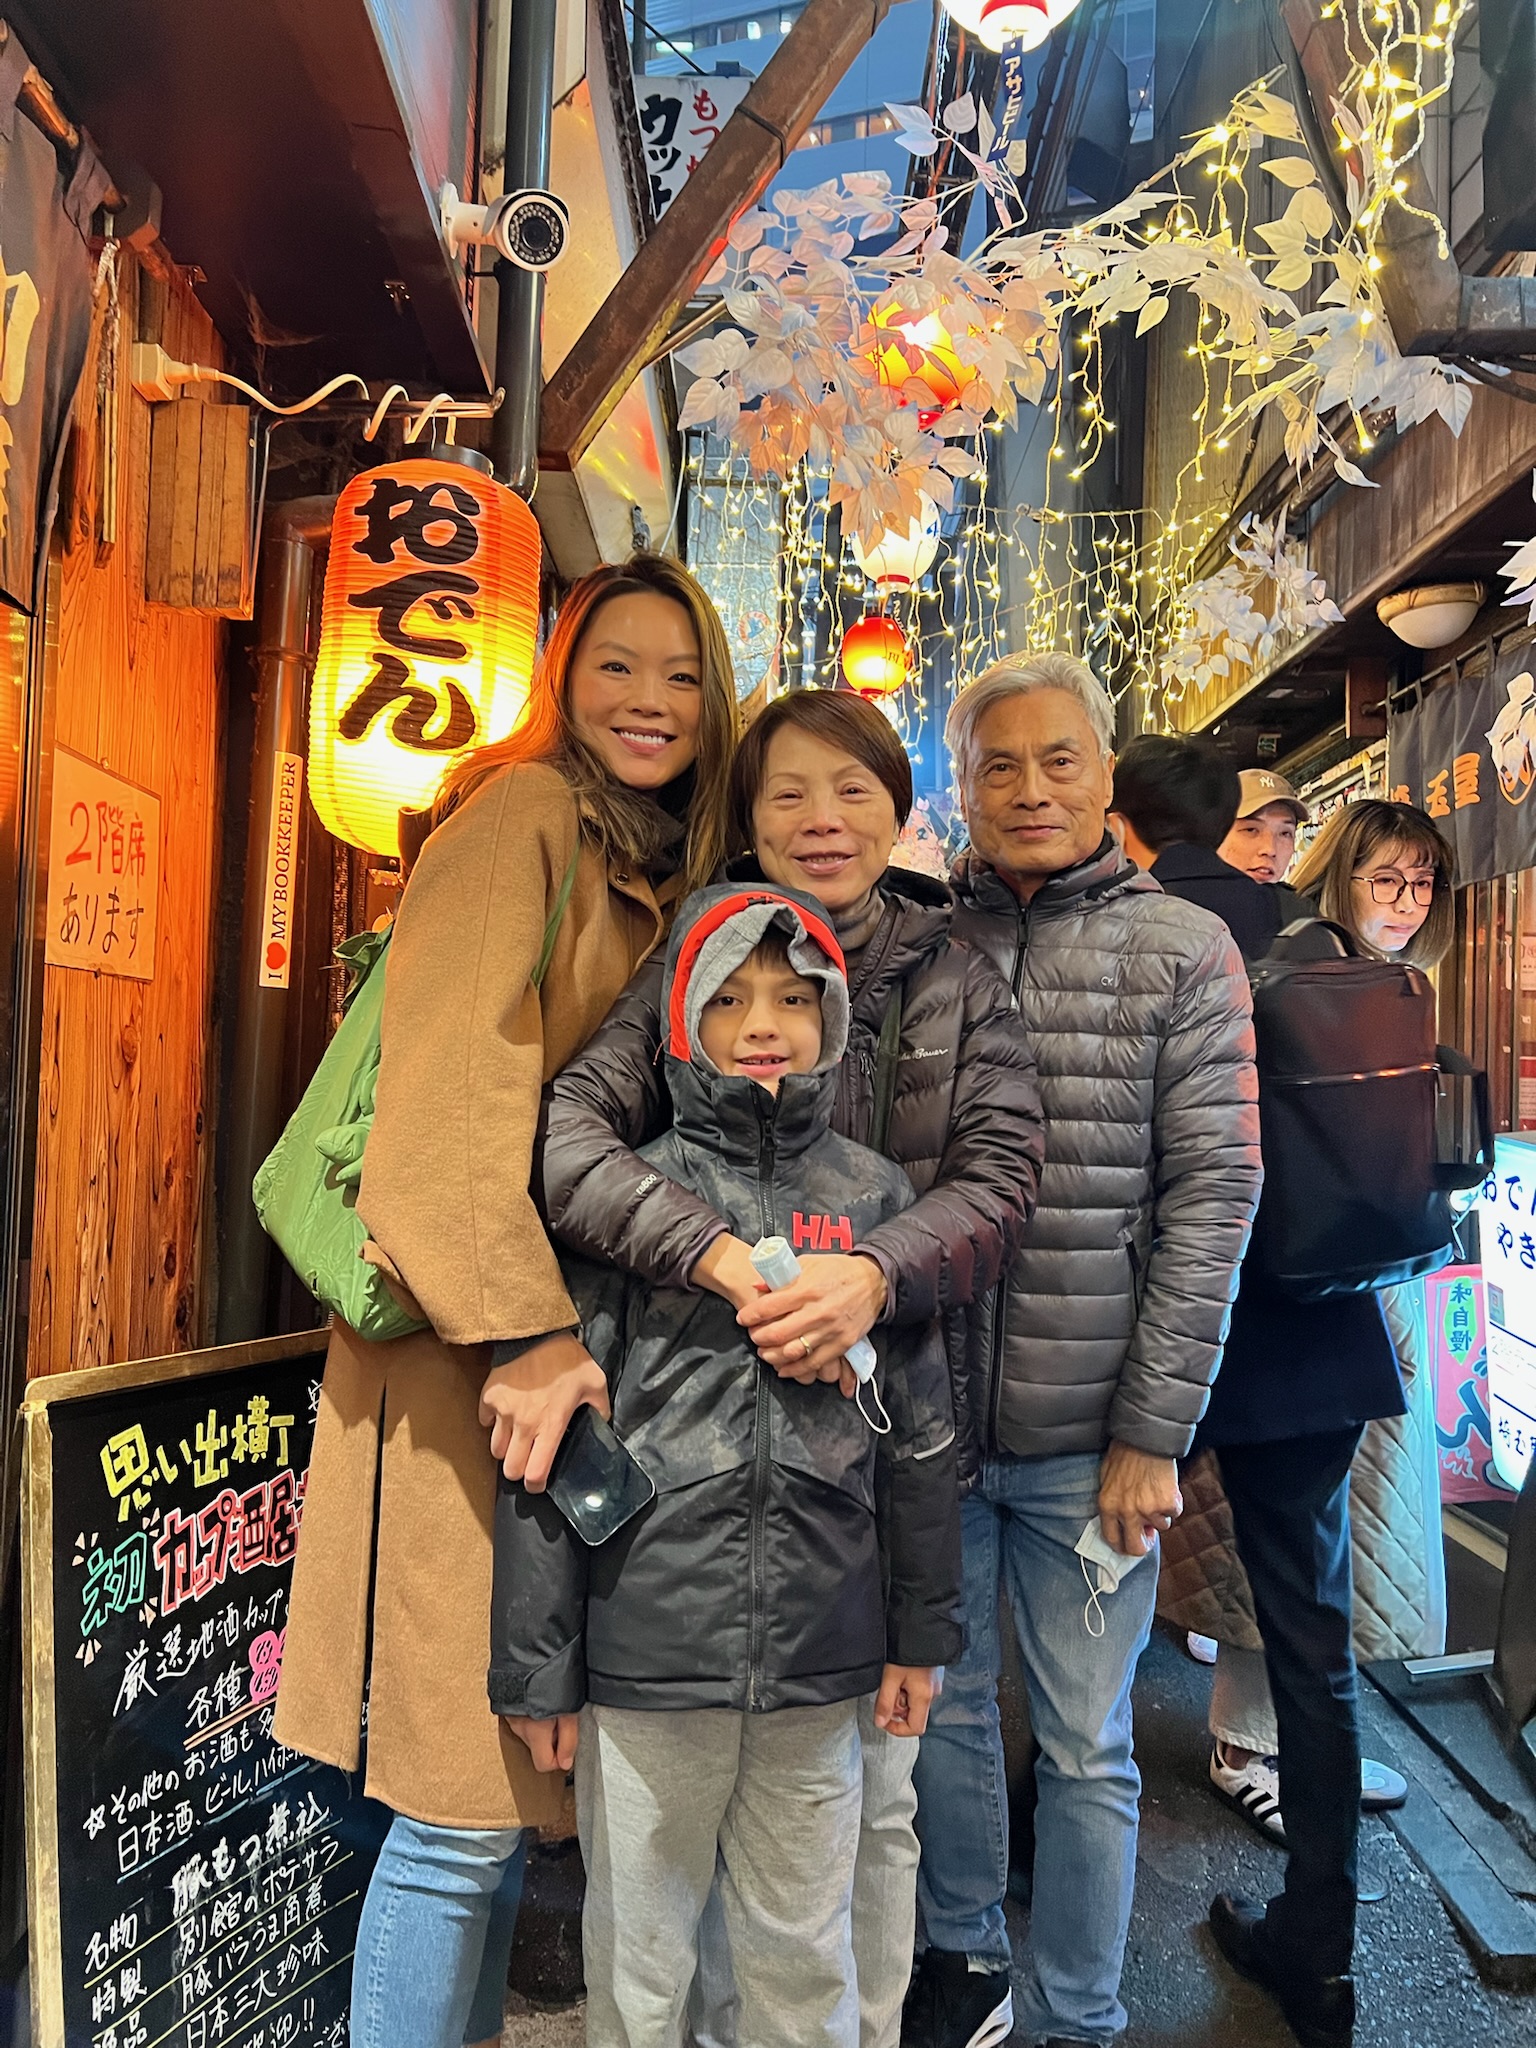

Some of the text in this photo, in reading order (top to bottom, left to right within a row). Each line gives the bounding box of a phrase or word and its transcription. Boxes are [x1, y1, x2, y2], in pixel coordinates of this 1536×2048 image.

[992, 55, 1023, 152] アサヒビール
[338, 477, 481, 751] おでん
[1259, 776, 1275, 788] NY
[65, 800, 146, 889] 2階席
[274, 761, 296, 902] BOOKKEEPER
[60, 882, 144, 959] あります
[270, 904, 288, 940] MY
[792, 1211, 853, 1250] HH
[99, 1395, 295, 1523] 思い出横丁
[113, 1588, 288, 1718] 厳選地酒カップ
[185, 1660, 248, 1729] 各種
[85, 1912, 138, 1974] 名物
[92, 1835, 339, 2023] 特製 別館のポテサラ
[186, 1926, 330, 2048] 日本三大珍味
